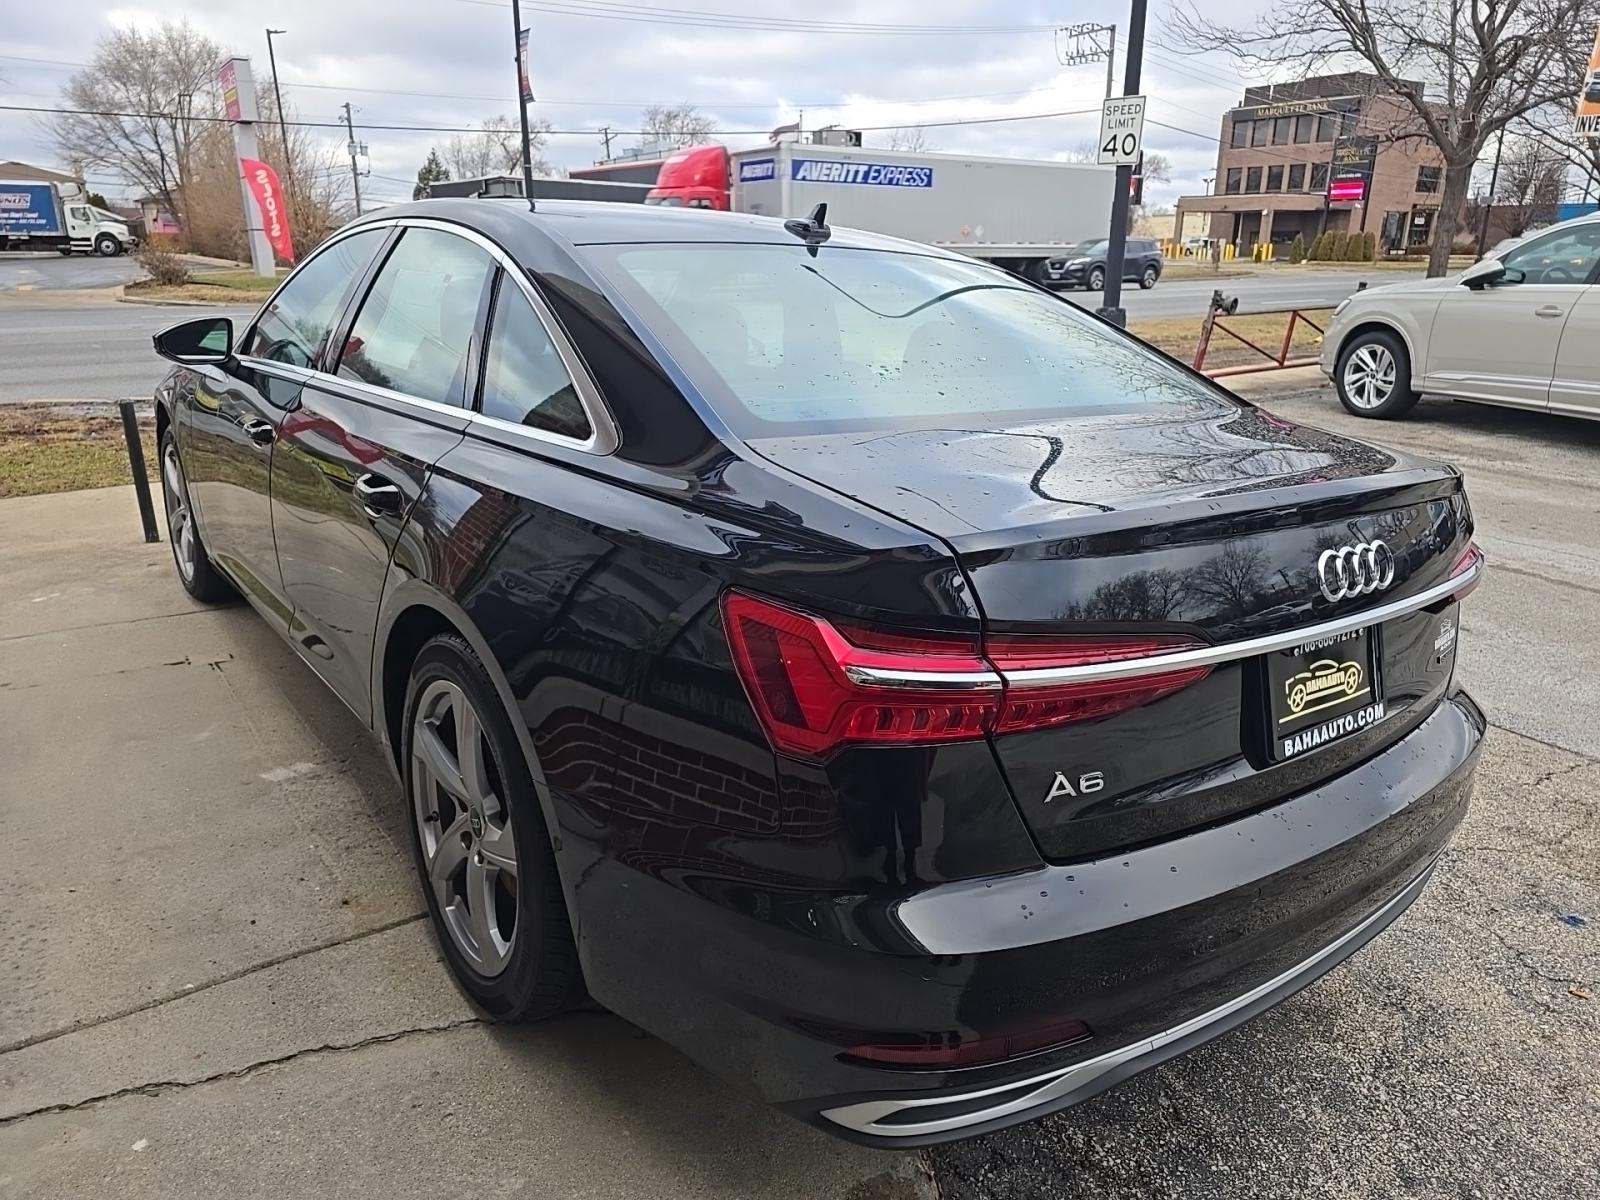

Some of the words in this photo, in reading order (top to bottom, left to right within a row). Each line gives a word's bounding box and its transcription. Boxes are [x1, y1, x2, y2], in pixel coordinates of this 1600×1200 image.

[1106, 104, 1142, 116] SPEED
[1108, 118, 1135, 129] LIMIT
[1102, 133, 1137, 156] 40
[796, 161, 869, 183] AVERITT
[867, 165, 931, 187] EXPRESS
[1305, 670, 1346, 694] BAHAAUTO
[1284, 702, 1384, 757] BAHAAUTO.COM
[1043, 771, 1104, 804] A6
